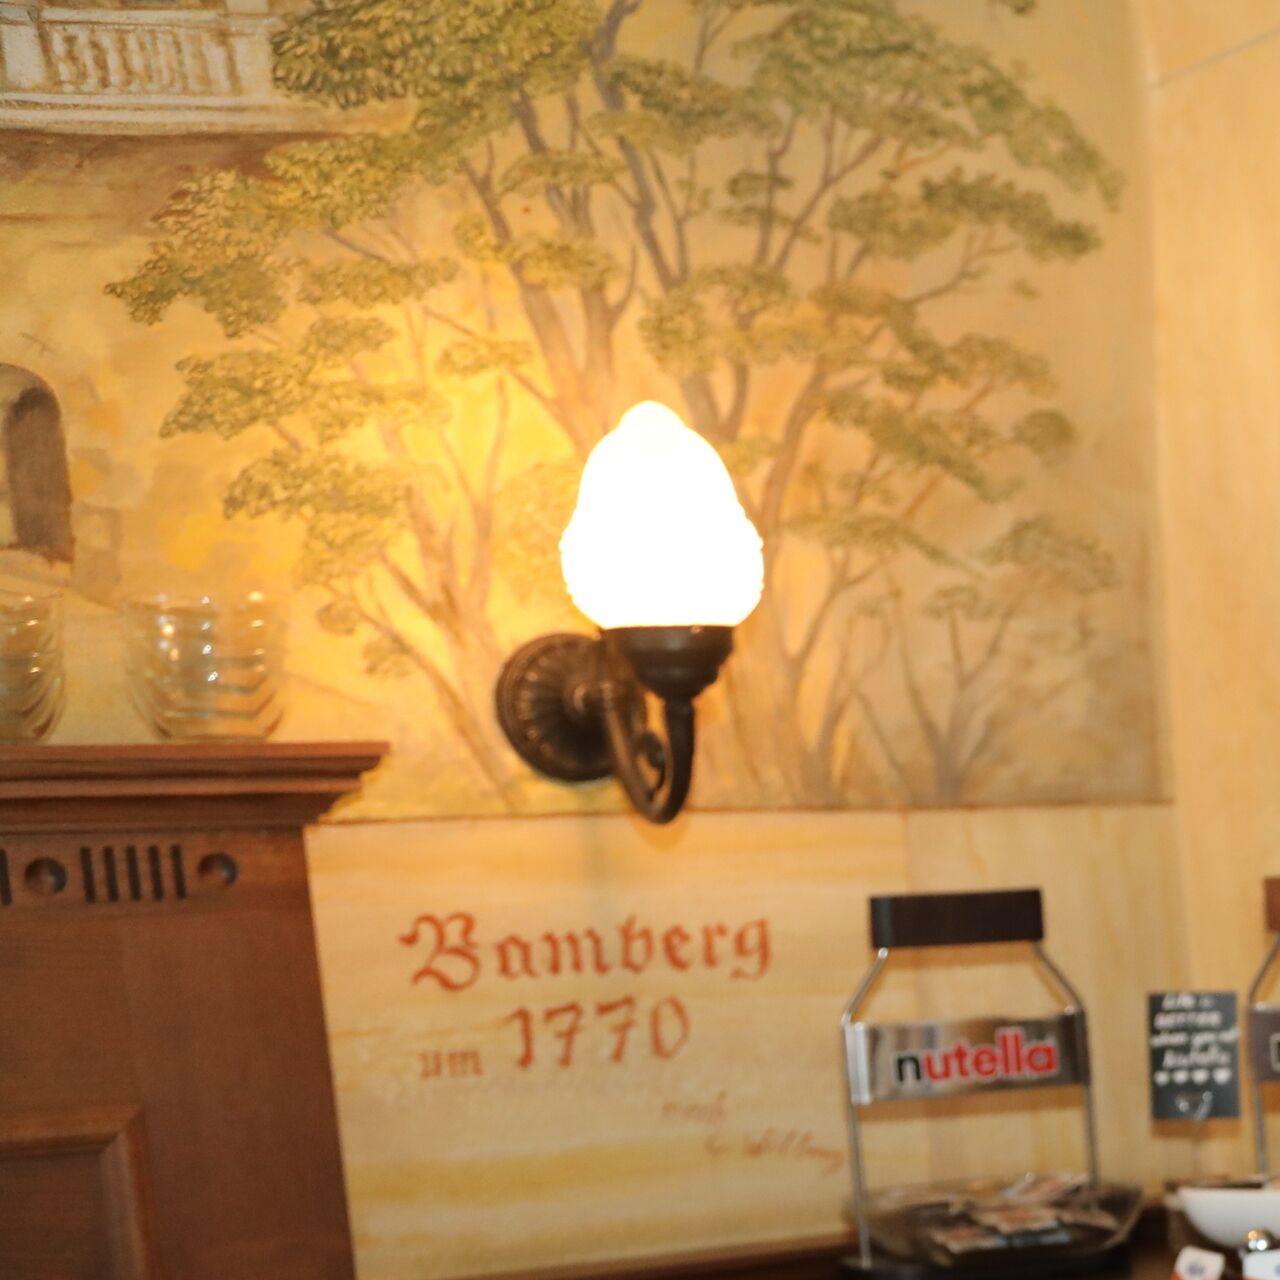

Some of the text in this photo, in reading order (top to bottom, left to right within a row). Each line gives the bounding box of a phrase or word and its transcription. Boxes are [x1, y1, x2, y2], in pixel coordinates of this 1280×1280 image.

[397, 911, 772, 991] Bamberg
[503, 995, 691, 1068] 1770
[896, 1027, 1060, 1084] nutella
